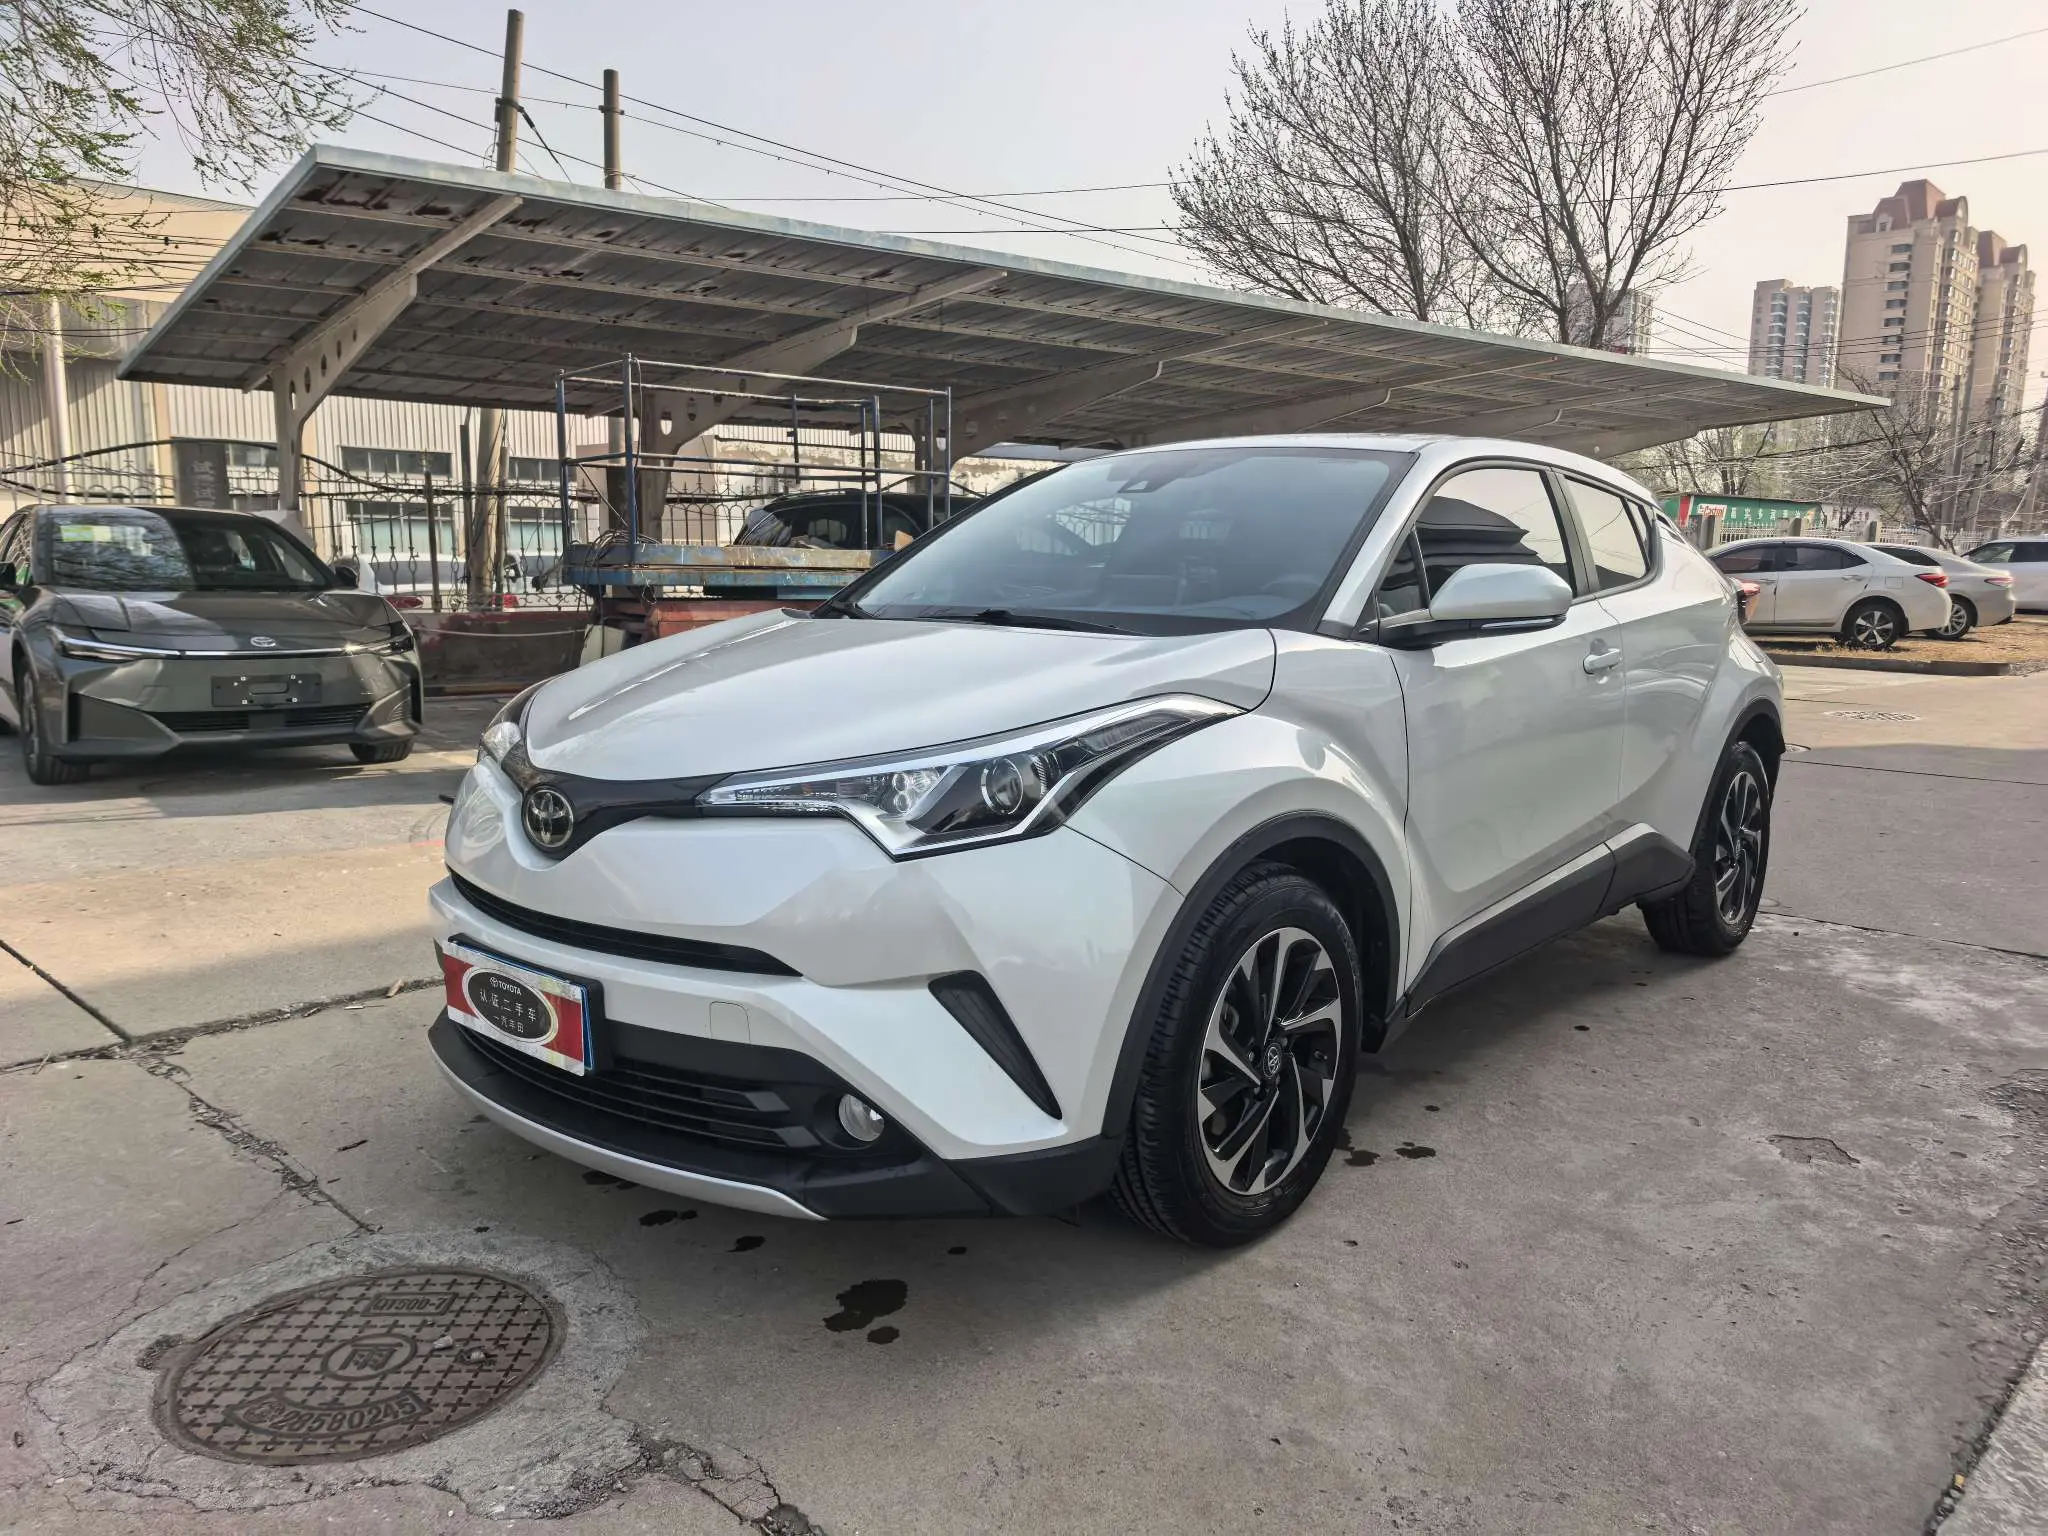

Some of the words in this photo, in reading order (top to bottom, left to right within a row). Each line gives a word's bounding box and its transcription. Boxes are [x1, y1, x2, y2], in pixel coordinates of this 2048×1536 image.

[499, 981, 522, 996] TOYOTA
[372, 1297, 448, 1311] QT500-7
[339, 1342, 404, 1371] 雨
